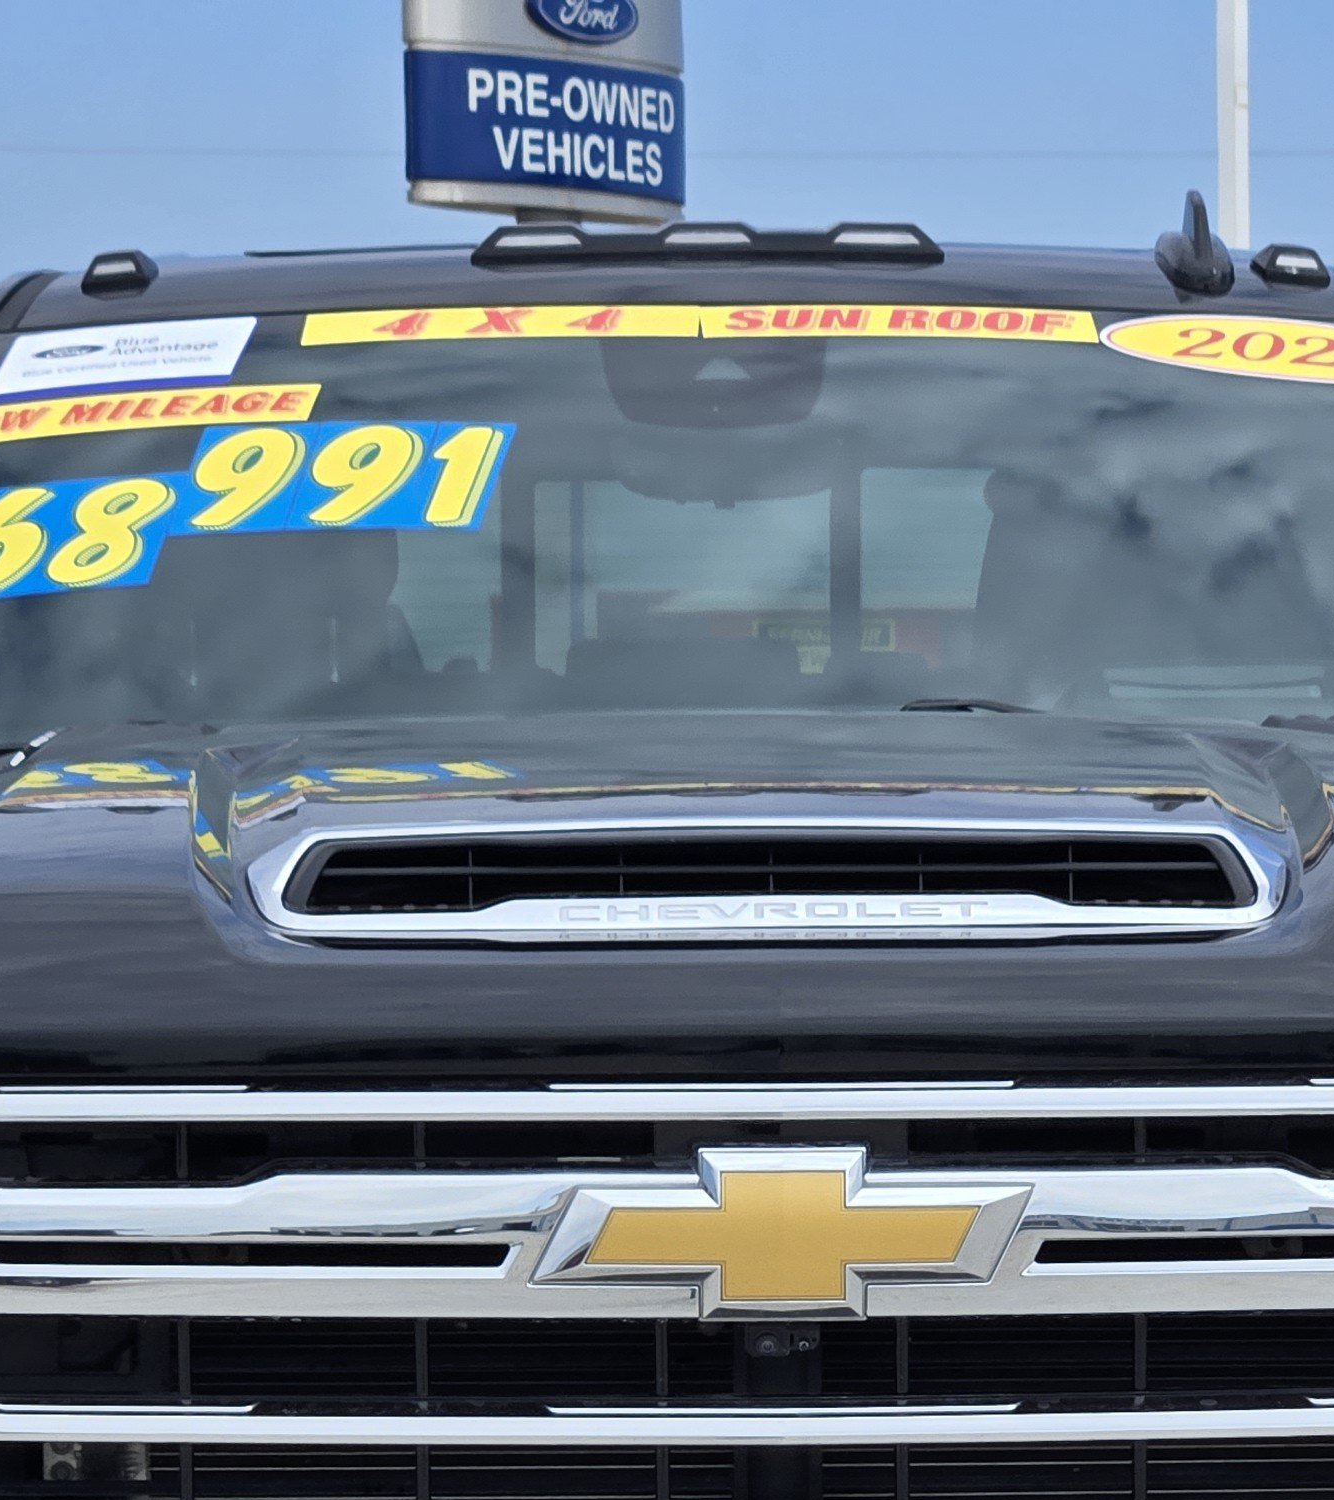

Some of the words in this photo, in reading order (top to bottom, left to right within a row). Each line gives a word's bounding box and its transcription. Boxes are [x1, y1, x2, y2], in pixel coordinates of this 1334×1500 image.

[559, 0, 619, 30] Ford
[466, 67, 676, 134] PRE-OWNED
[492, 126, 664, 187] VEHICLES
[373, 308, 431, 336] 4
[566, 306, 622, 333] 4
[724, 308, 871, 332] SUN
[887, 309, 1076, 337] ROOF
[108, 341, 219, 357] Advantage
[59, 390, 310, 426] MILEAGE
[558, 901, 989, 923] CHEVROLET
